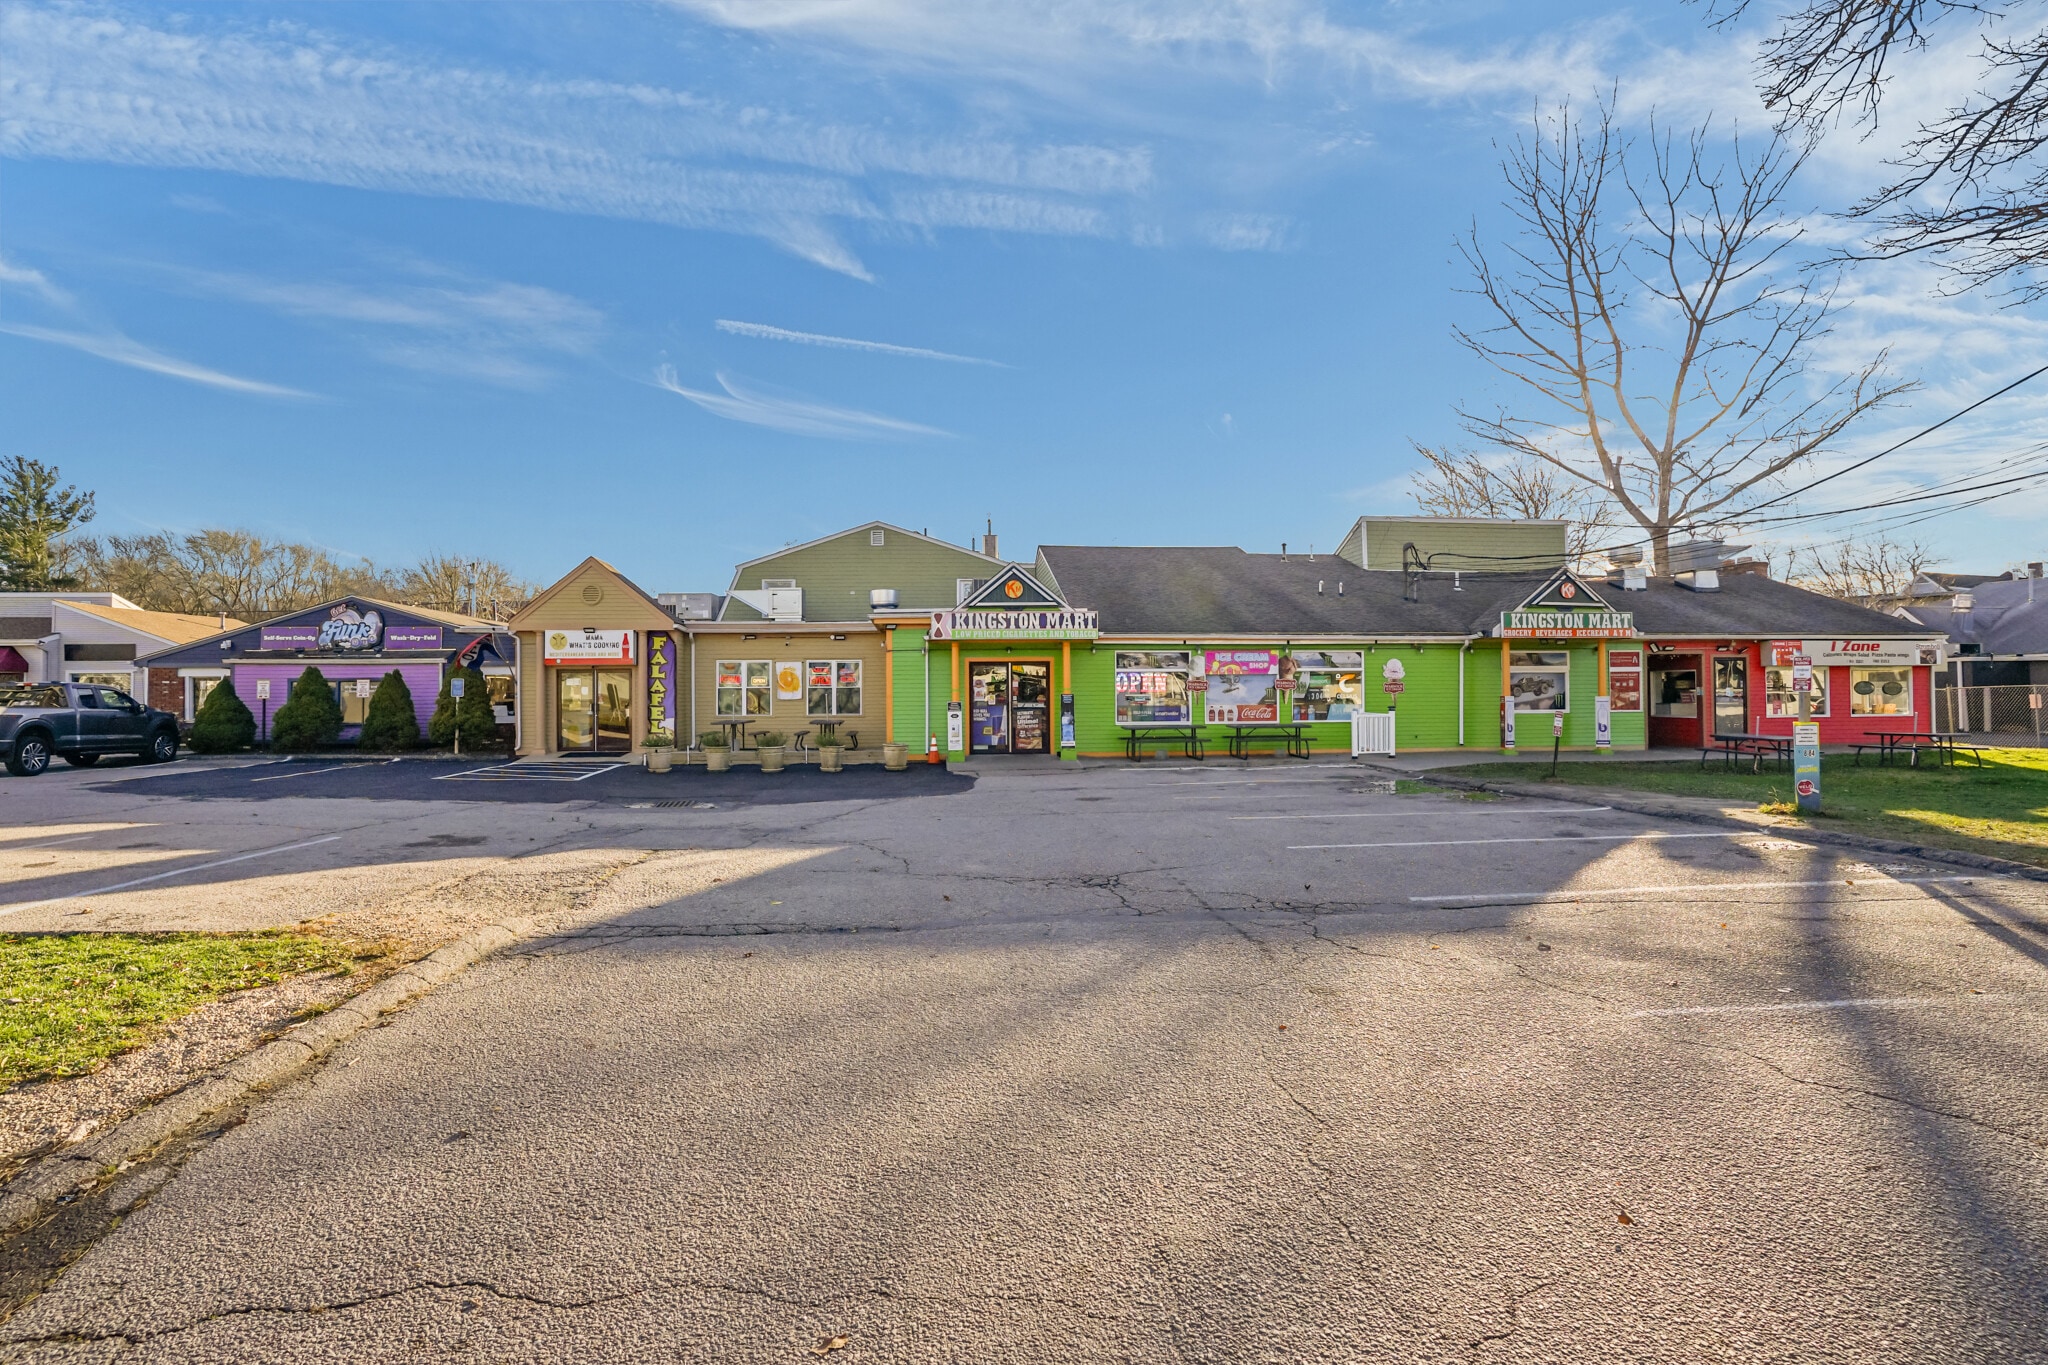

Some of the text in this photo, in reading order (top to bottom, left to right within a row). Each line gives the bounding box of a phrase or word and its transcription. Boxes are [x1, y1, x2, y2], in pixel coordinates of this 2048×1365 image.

[955, 612, 1098, 630] KINGSTON MART
[1511, 613, 1632, 628] KINGSTON MART
[319, 619, 372, 646] Funk
[955, 630, 1098, 639] LOW PRICED CIGARETTES AND TOBACCO
[1503, 629, 1532, 637] GROCERY
[1535, 629, 1573, 637] BEVERAGES
[1830, 640, 1881, 652] I Zone
[1214, 652, 1270, 662] ICE CREAM
[650, 636, 668, 734] FALAFEL
[1115, 672, 1168, 693] OPEN
